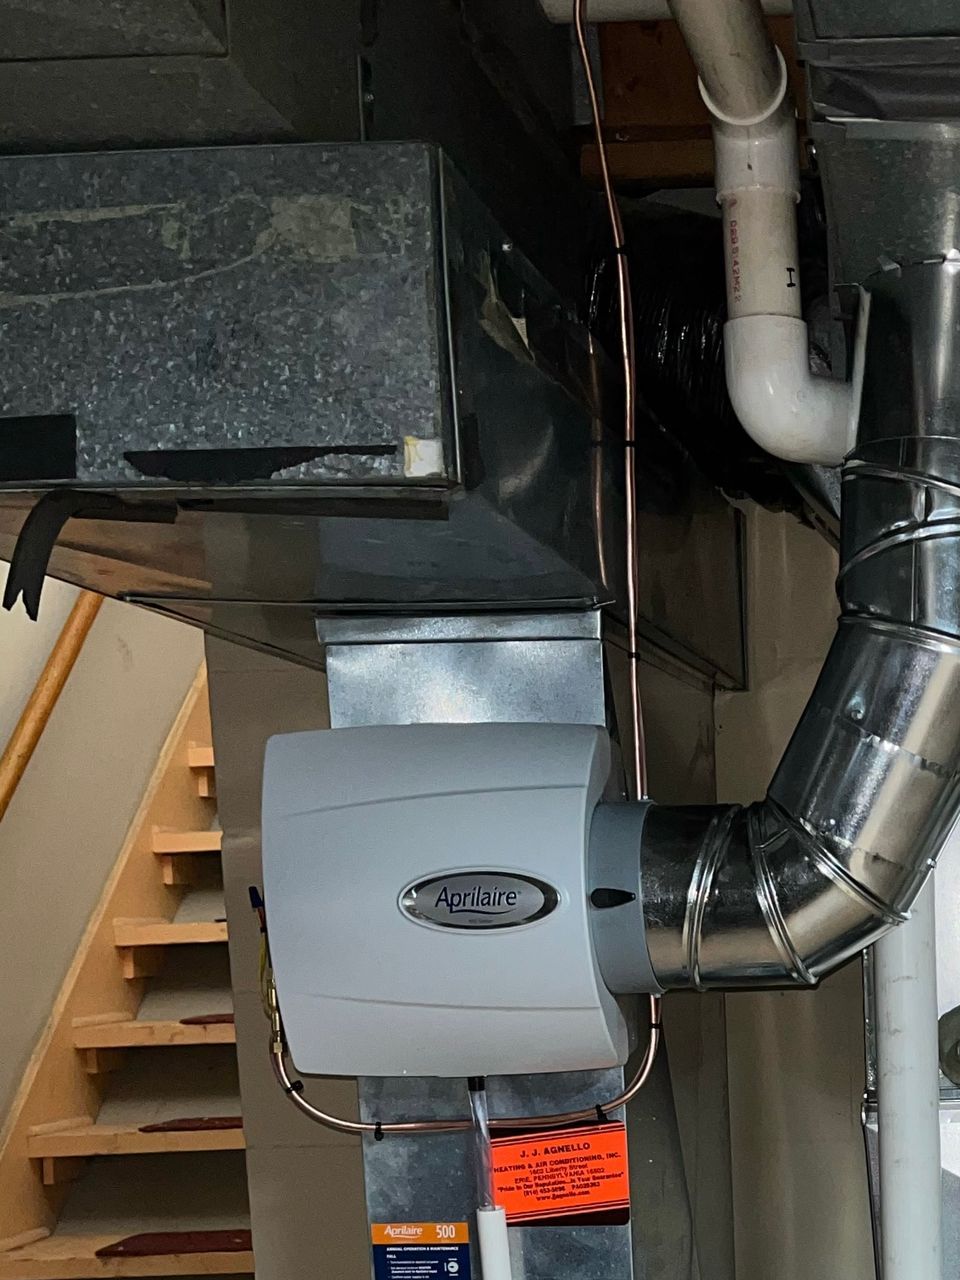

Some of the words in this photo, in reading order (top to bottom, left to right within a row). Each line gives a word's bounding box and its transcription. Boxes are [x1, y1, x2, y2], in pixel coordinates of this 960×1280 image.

[434, 886, 518, 914] Aprilaire
[520, 1150, 529, 1158] J.
[532, 1148, 541, 1157] J.
[543, 1142, 591, 1155] AGNELLO
[494, 1165, 526, 1173] HEATING
[549, 1154, 604, 1166] CONDITIONING,
[546, 1166, 568, 1174] Liberty
[569, 1163, 588, 1171] Street
[533, 1171, 585, 1181] PENNSYLVANIA
[384, 1225, 423, 1238] Aprilaire
[436, 1225, 456, 1239] 500
